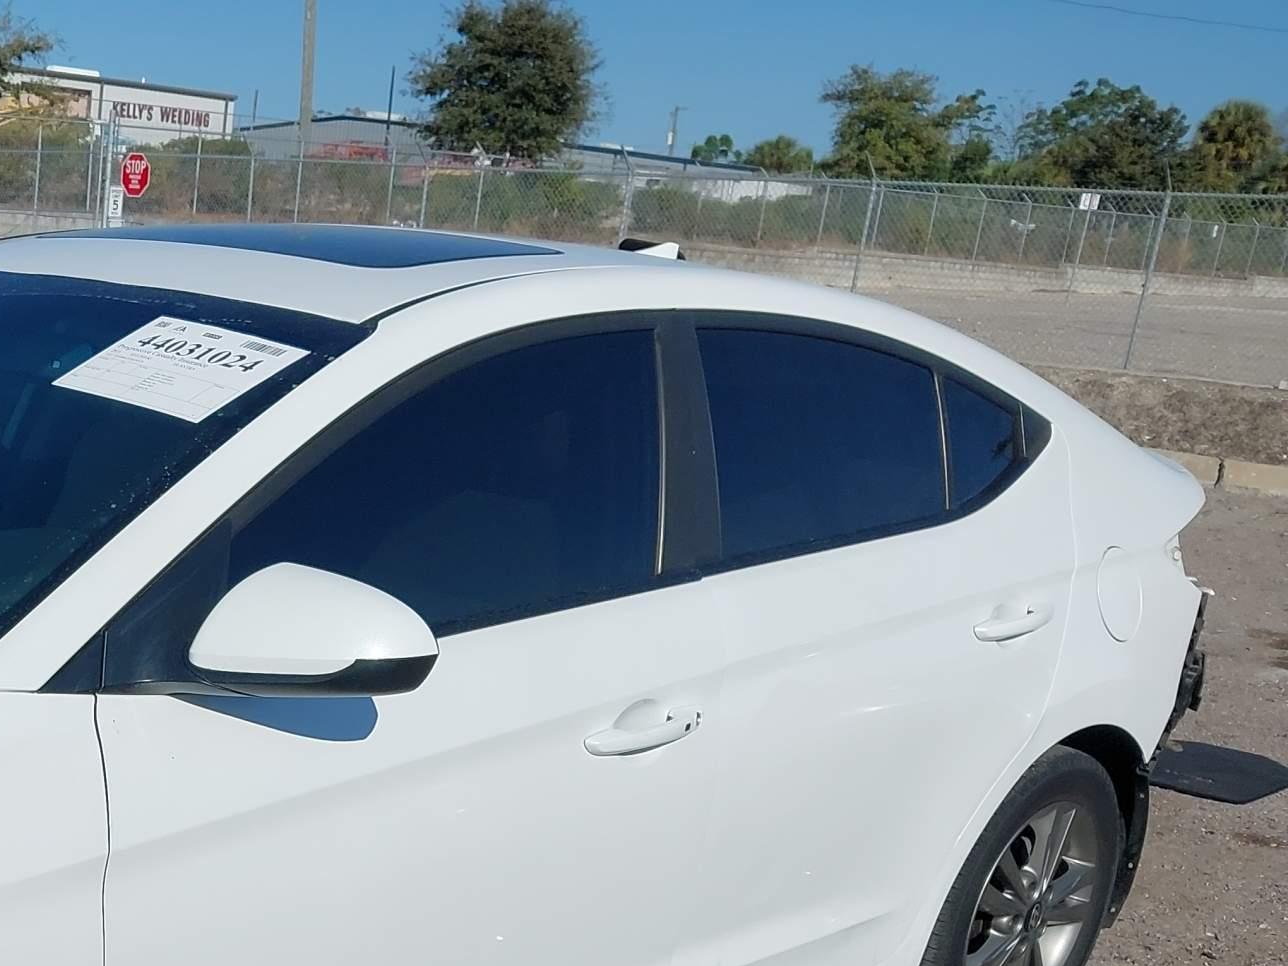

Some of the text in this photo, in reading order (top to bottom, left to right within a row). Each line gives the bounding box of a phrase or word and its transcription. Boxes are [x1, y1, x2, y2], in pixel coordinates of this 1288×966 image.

[112, 101, 210, 128] KELLY'S WELDING
[125, 160, 147, 174] STOP
[112, 199, 119, 211] 5
[137, 334, 264, 373] 44031024
